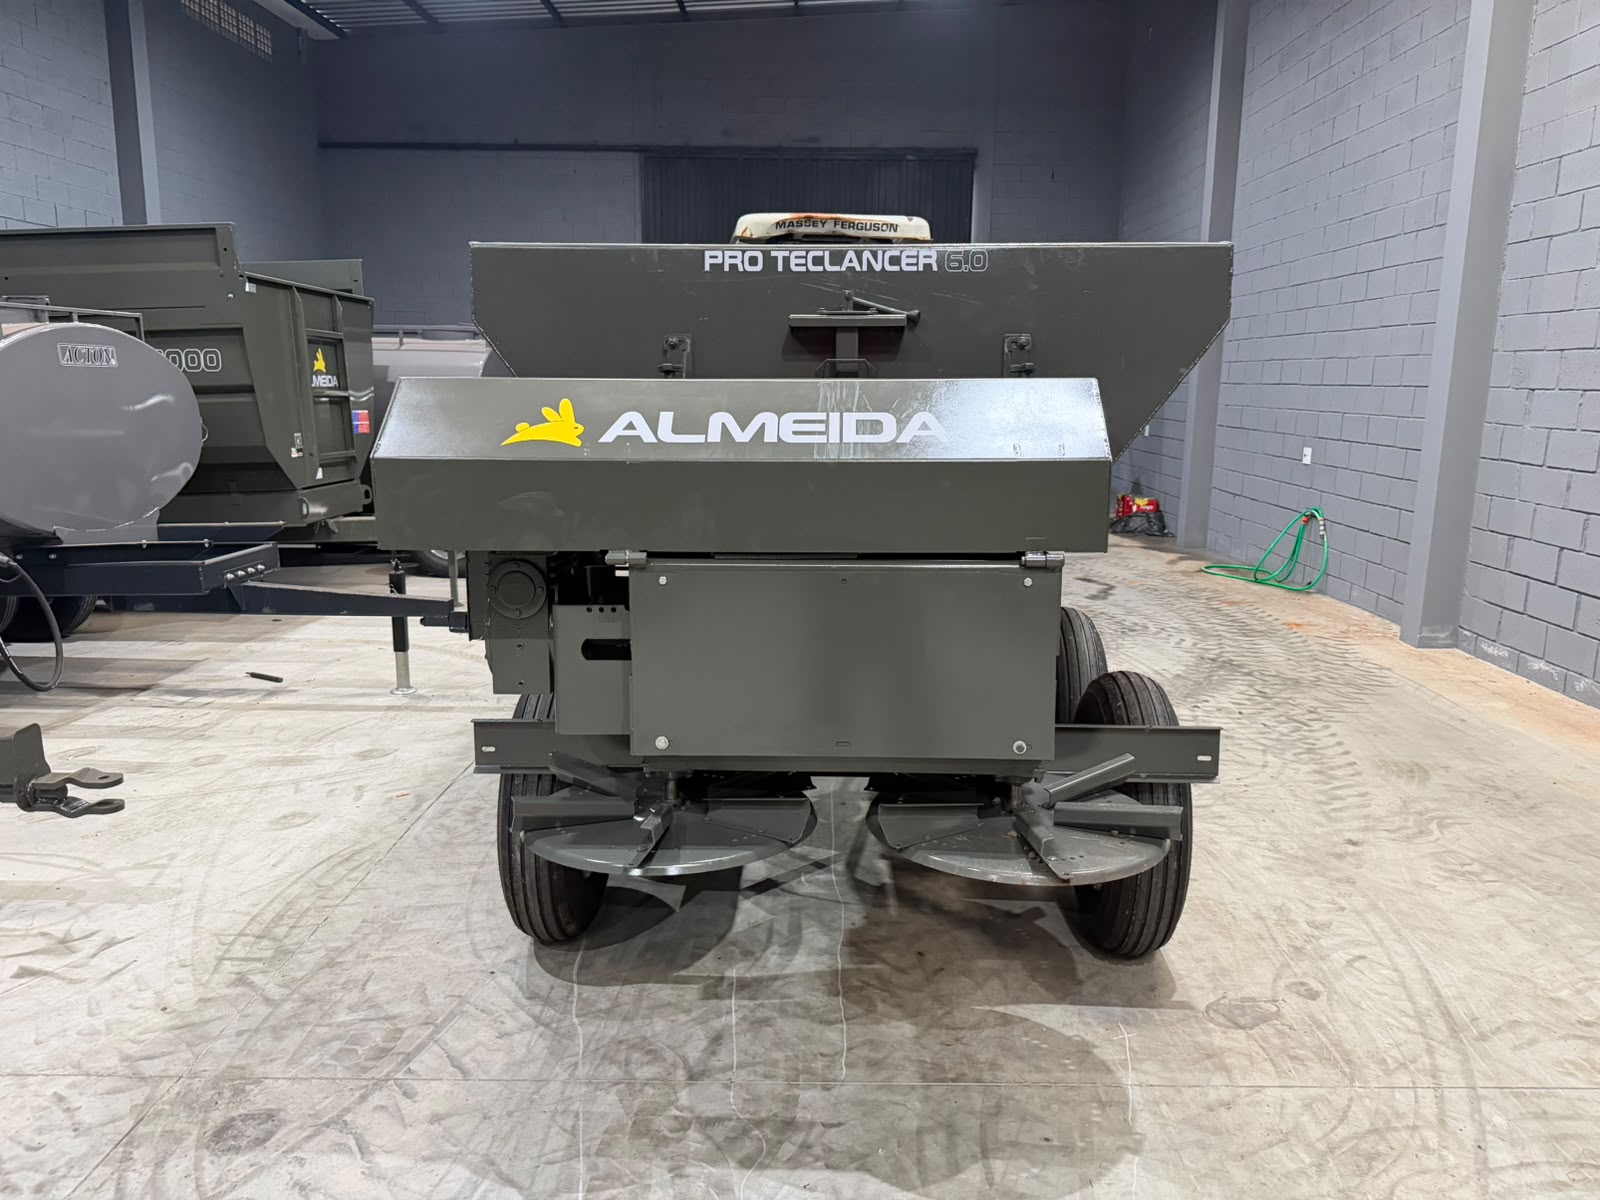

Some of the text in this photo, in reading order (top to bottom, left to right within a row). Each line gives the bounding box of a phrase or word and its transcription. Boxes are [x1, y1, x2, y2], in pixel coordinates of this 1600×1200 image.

[775, 219, 899, 233] MASSEY FERGUSON
[704, 250, 989, 272] PRO TECLANCER 6.0
[62, 346, 115, 365] ACTON
[156, 348, 222, 373] 000
[598, 411, 951, 443] ALMEIDA
